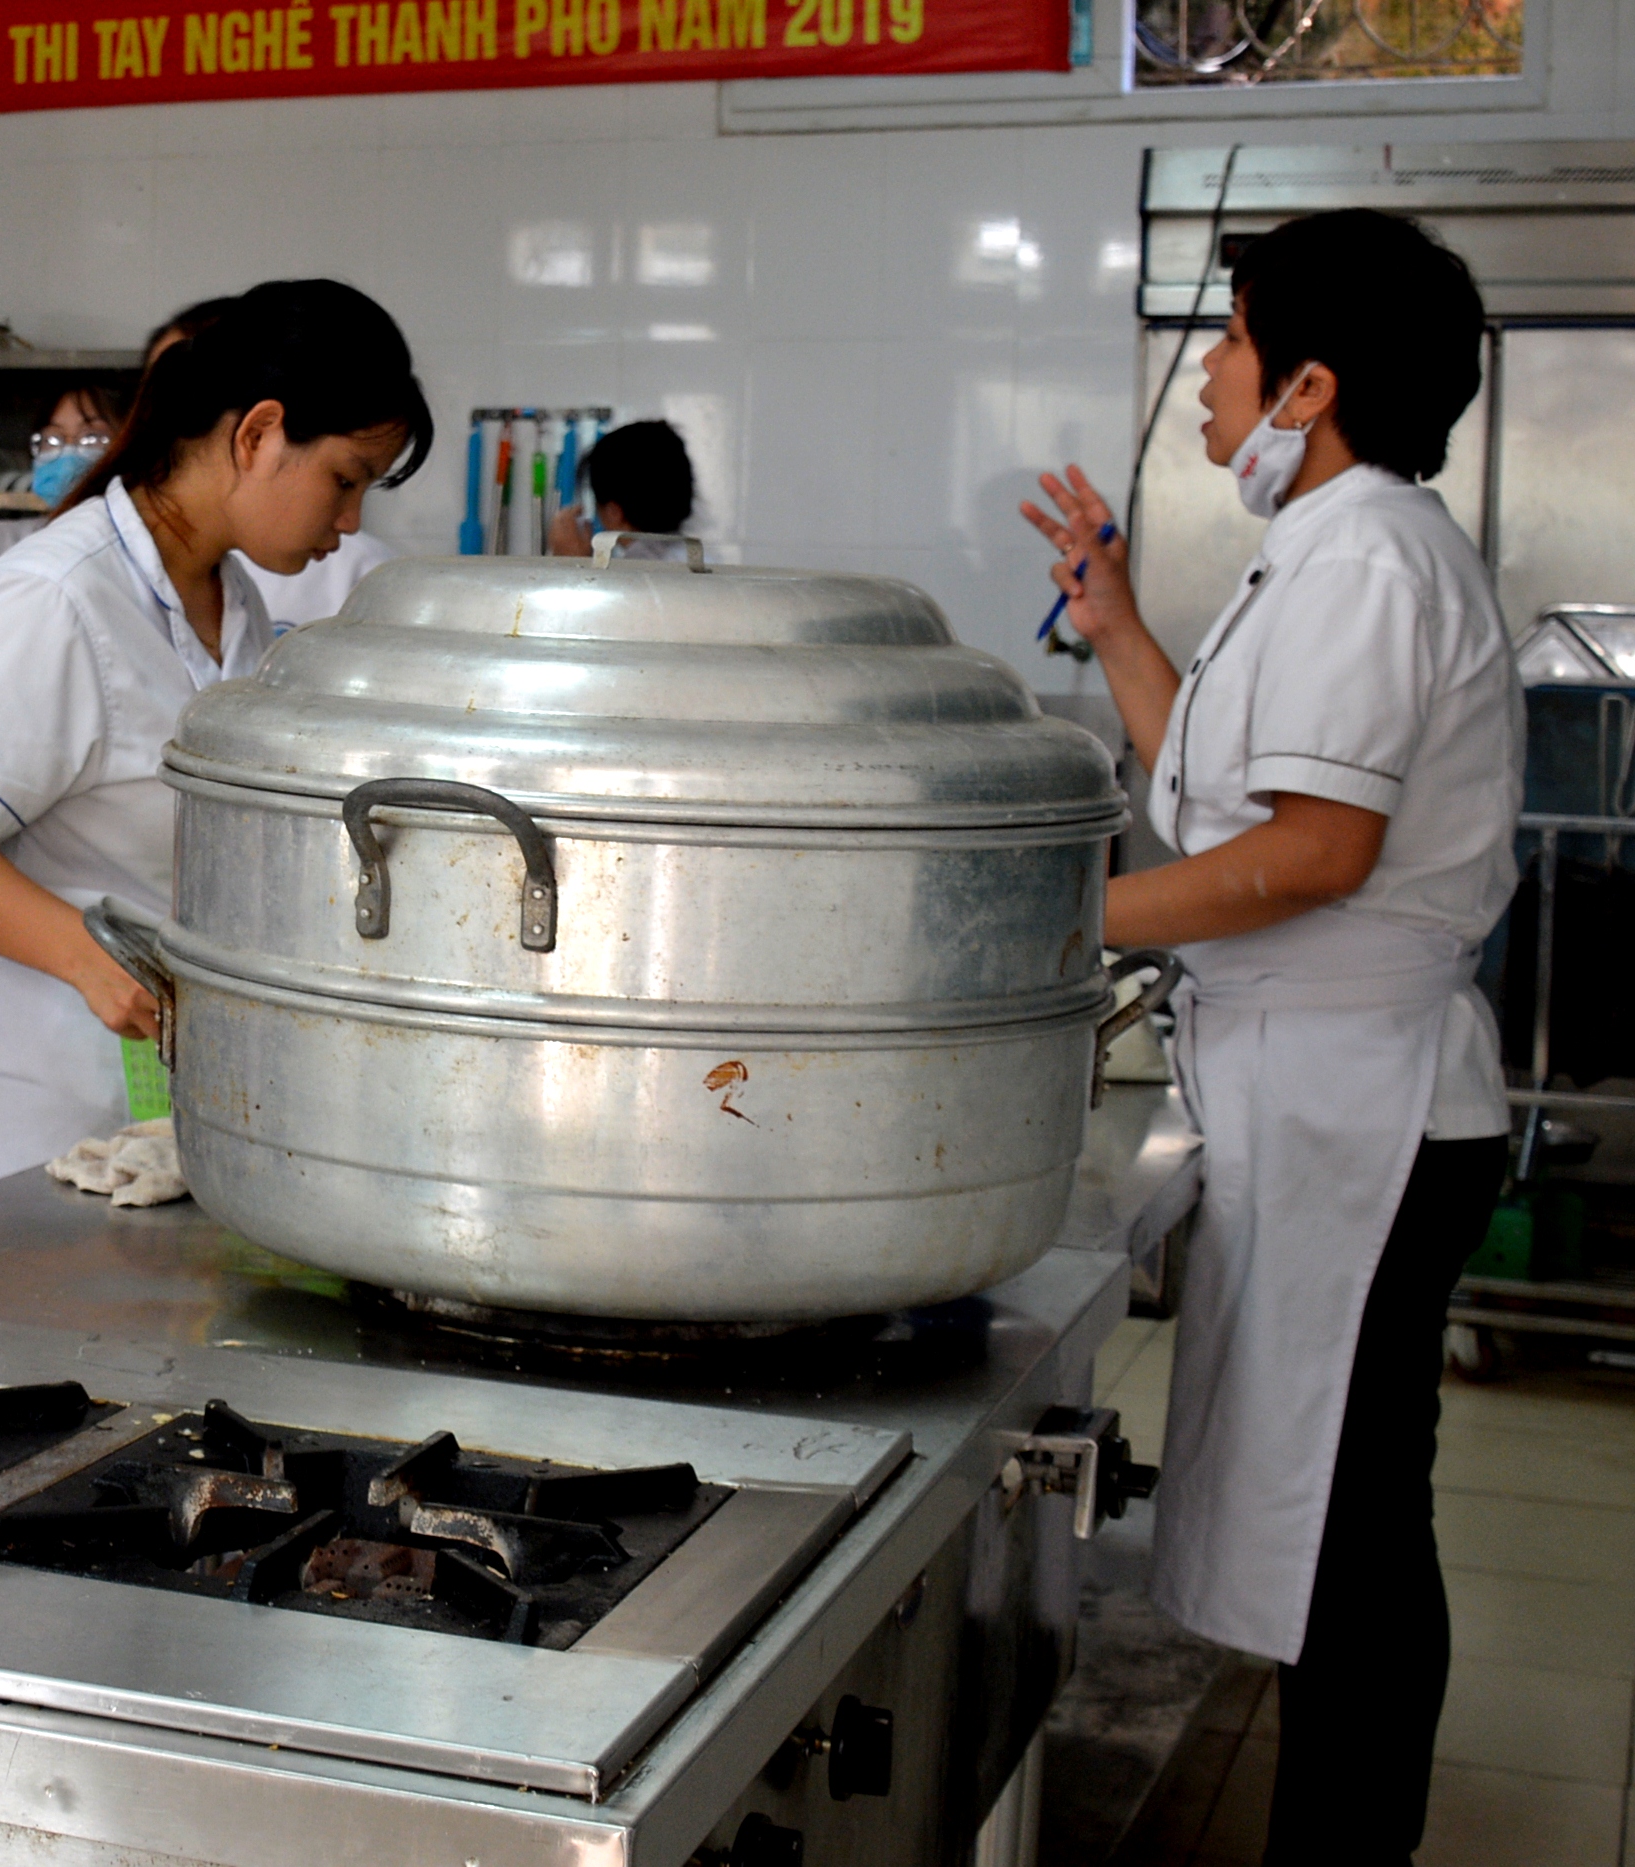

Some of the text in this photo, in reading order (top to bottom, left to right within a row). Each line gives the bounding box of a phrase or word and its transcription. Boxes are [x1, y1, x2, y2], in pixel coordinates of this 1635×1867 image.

[9, 21, 78, 84] THI
[93, 16, 169, 79] TAY
[782, 0, 925, 48] 2019
